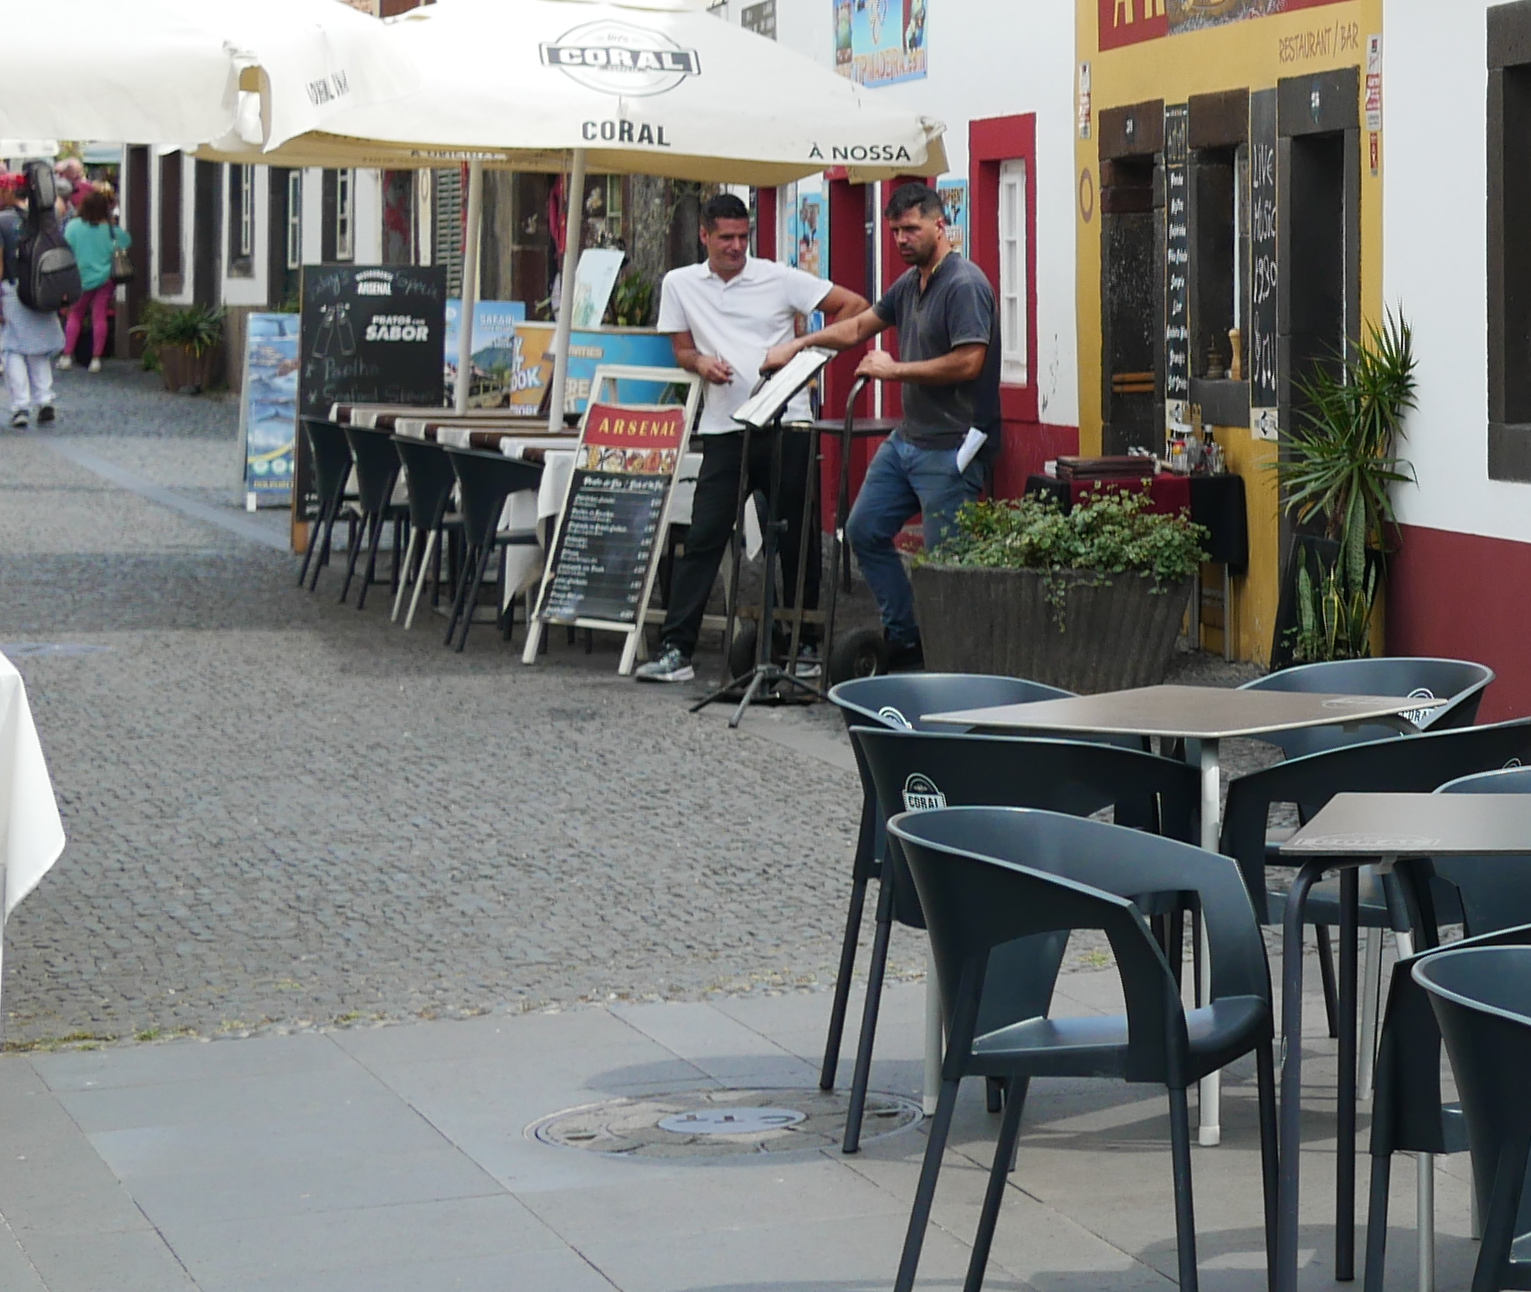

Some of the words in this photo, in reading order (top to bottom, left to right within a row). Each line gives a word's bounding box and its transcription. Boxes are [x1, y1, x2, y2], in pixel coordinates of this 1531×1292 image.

[559, 48, 684, 70] CORAL
[581, 119, 671, 146] CORAL
[808, 142, 825, 160] À
[831, 145, 911, 162] NOSSA
[1253, 144, 1274, 188] LIVE
[365, 325, 429, 342] SABOR
[598, 416, 677, 437] ARSENAL
